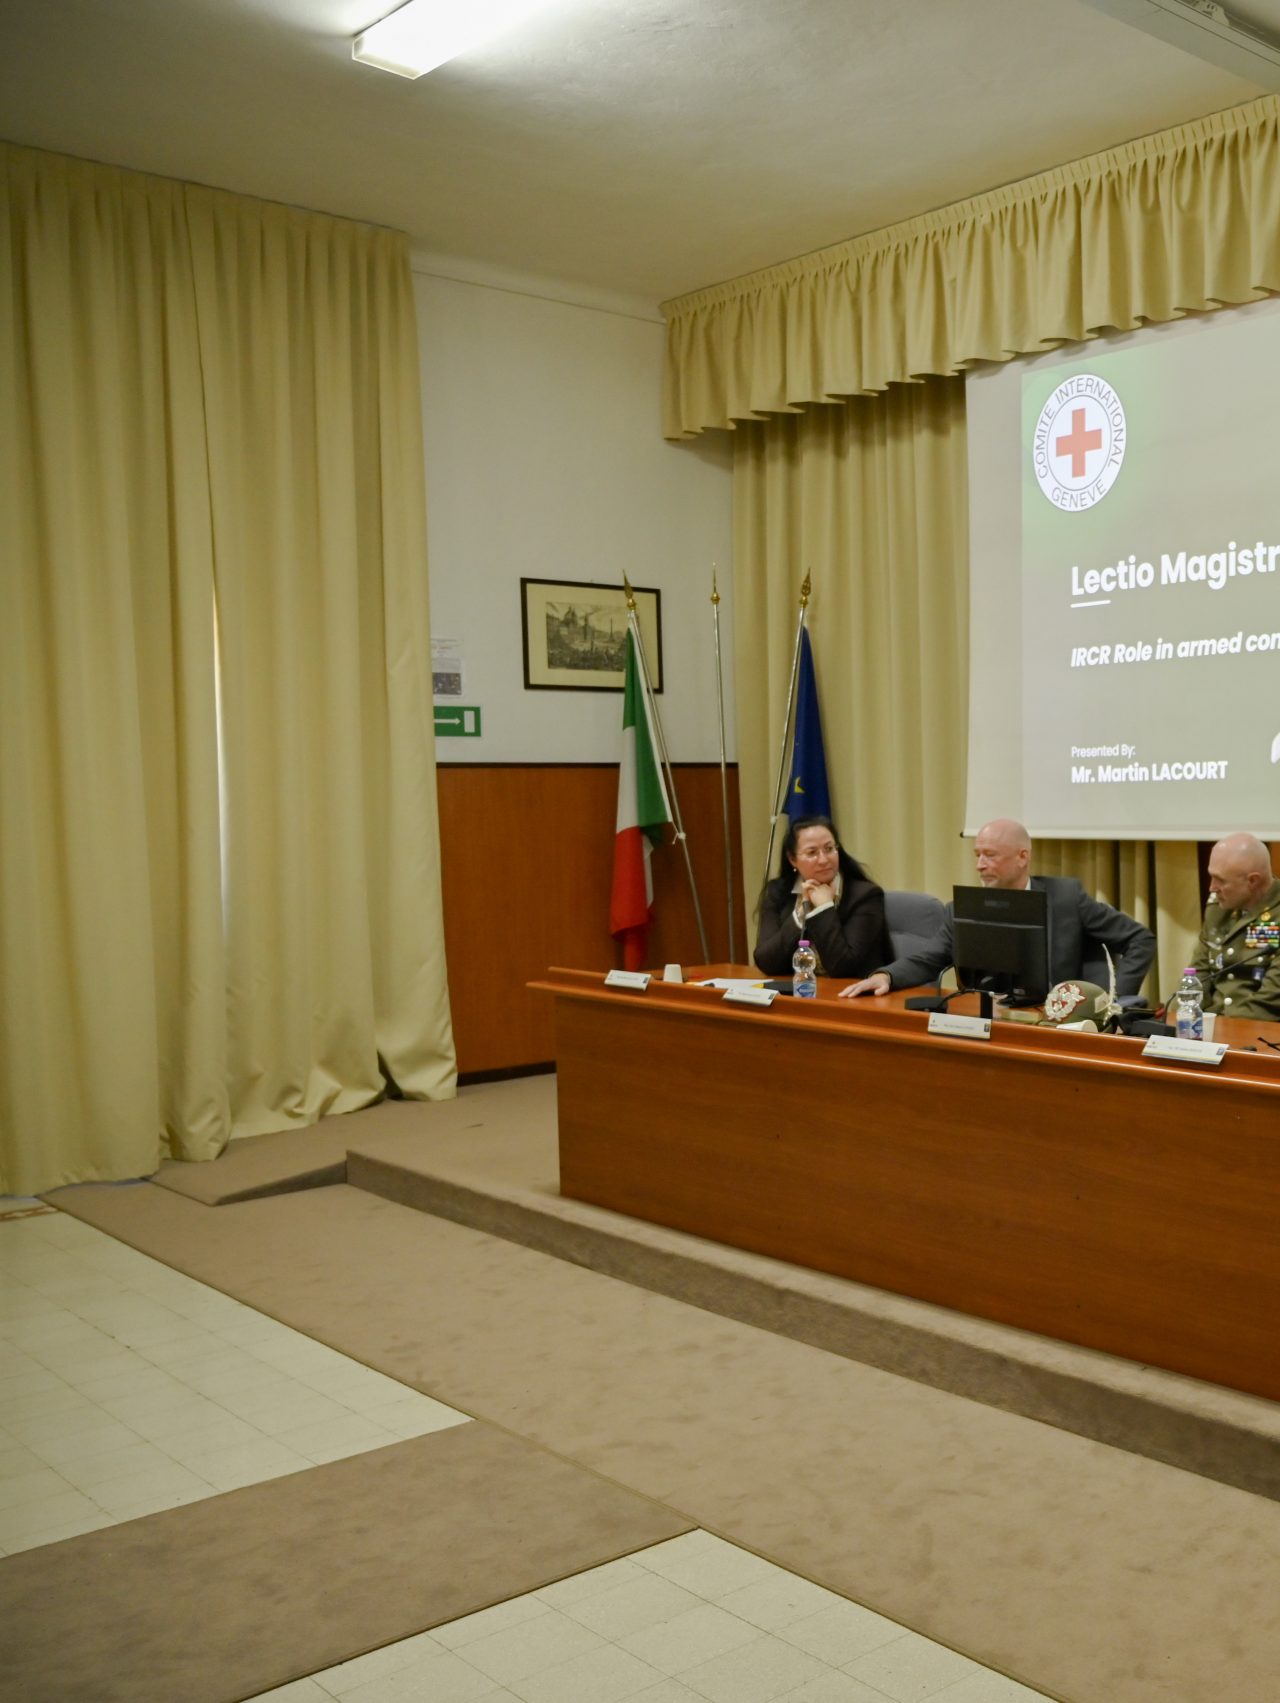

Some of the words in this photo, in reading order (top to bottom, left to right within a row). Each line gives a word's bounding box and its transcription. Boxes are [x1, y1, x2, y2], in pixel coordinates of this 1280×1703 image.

[1035, 404, 1055, 479] COMITE
[1055, 377, 1124, 468] INTERNATIONAL
[1051, 478, 1107, 508] GENEVE
[1071, 554, 1155, 596] Lectio
[1070, 644, 1110, 668] IRCR
[1113, 641, 1153, 664] Role
[1155, 637, 1174, 660] in
[1176, 631, 1243, 659] armed
[1071, 744, 1120, 758] Presented
[1120, 743, 1136, 759] By:
[1071, 765, 1096, 783] Mr.
[1098, 761, 1150, 783] Martin
[1151, 761, 1228, 781] LACOURT
